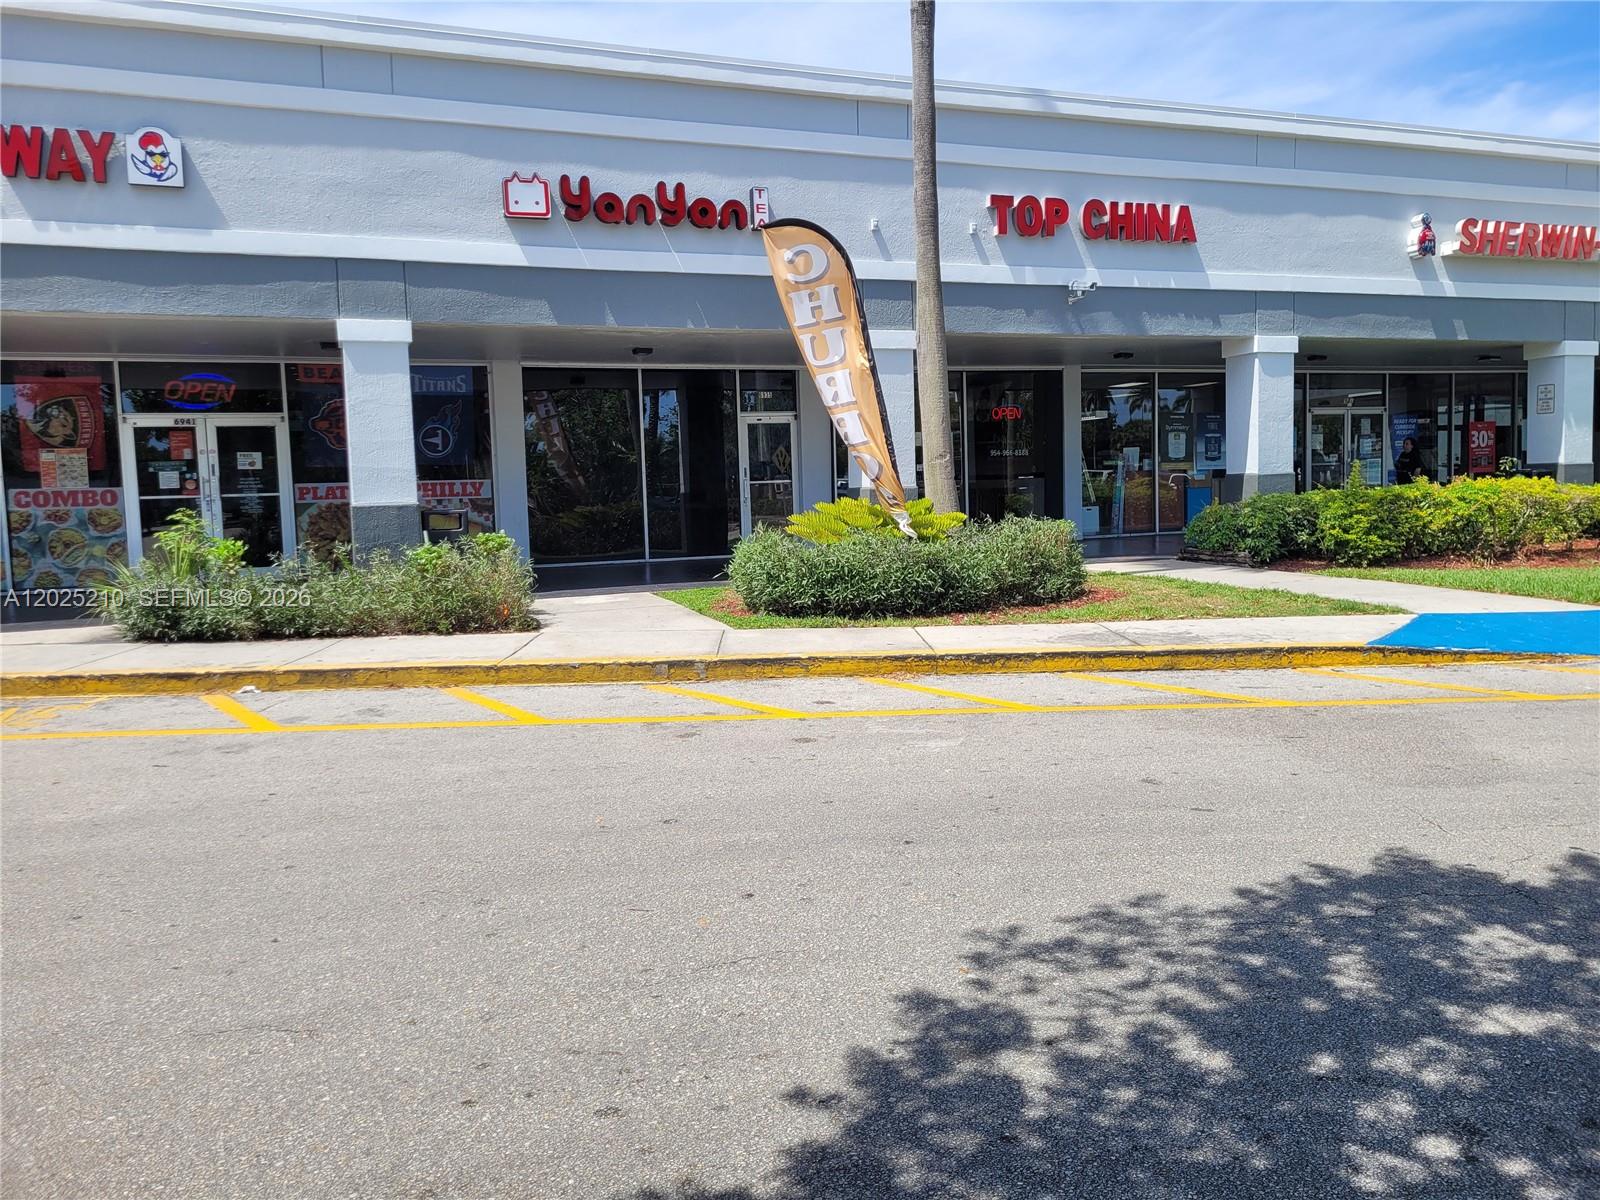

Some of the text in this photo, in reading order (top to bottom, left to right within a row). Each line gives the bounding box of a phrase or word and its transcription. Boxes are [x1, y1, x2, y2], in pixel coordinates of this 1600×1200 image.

[0, 124, 116, 184] WAY
[753, 187, 770, 228] TEA
[987, 194, 1198, 243] TOP CHINA
[164, 380, 237, 402] OPEN
[174, 418, 196, 426] 6941
[992, 407, 1022, 419] OPEN
[13, 490, 119, 509] COMBO
